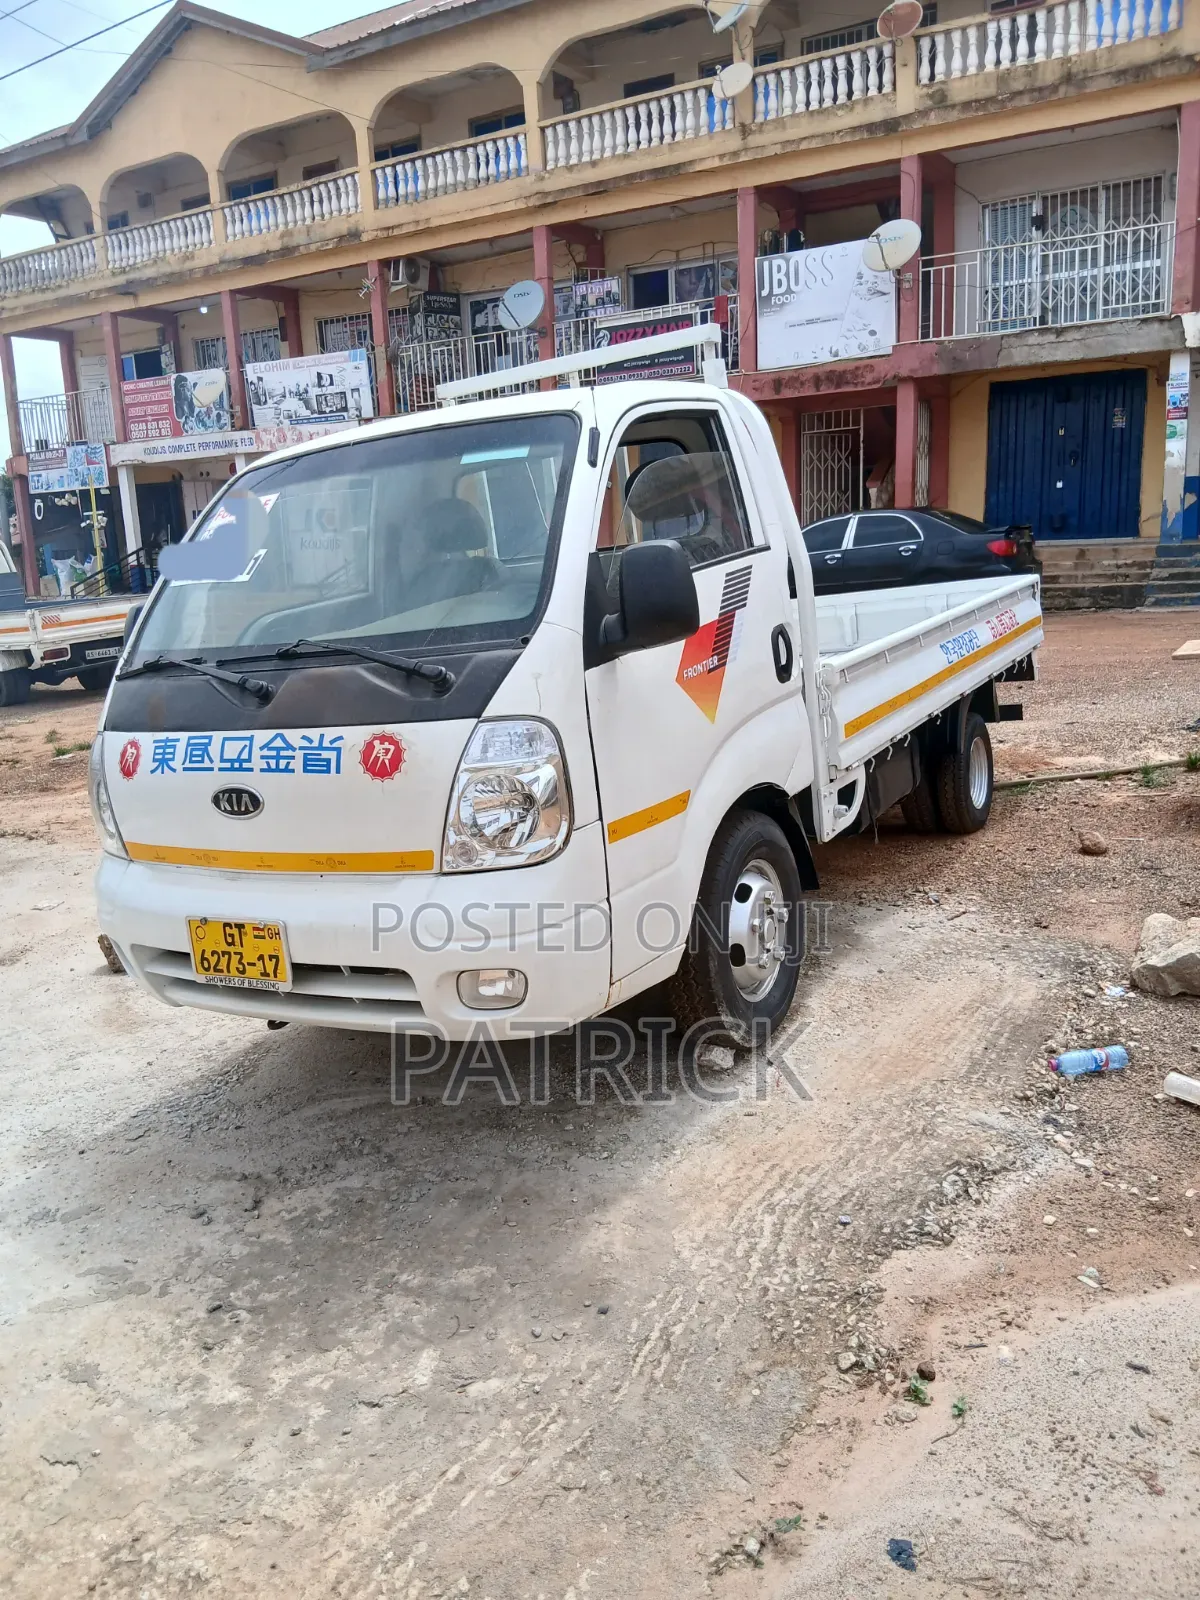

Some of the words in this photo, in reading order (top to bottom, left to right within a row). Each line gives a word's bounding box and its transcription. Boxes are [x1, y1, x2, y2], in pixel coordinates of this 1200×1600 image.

[761, 250, 834, 297] JBOSS
[771, 294, 797, 305] FOOD
[610, 325, 653, 346] JOZZY
[252, 361, 291, 374] ELOHIM
[146, 403, 169, 414] ENGLISH
[168, 443, 196, 454] COMPLETE
[683, 655, 719, 681] FRONTIER
[217, 792, 255, 812] KIA
[222, 922, 246, 948] GT
[267, 927, 281, 940] GH
[200, 948, 280, 979] 6273-17
[205, 975, 236, 986] SHOWERS
[237, 979, 246, 987] OF
[247, 980, 280, 991] BLESSING
